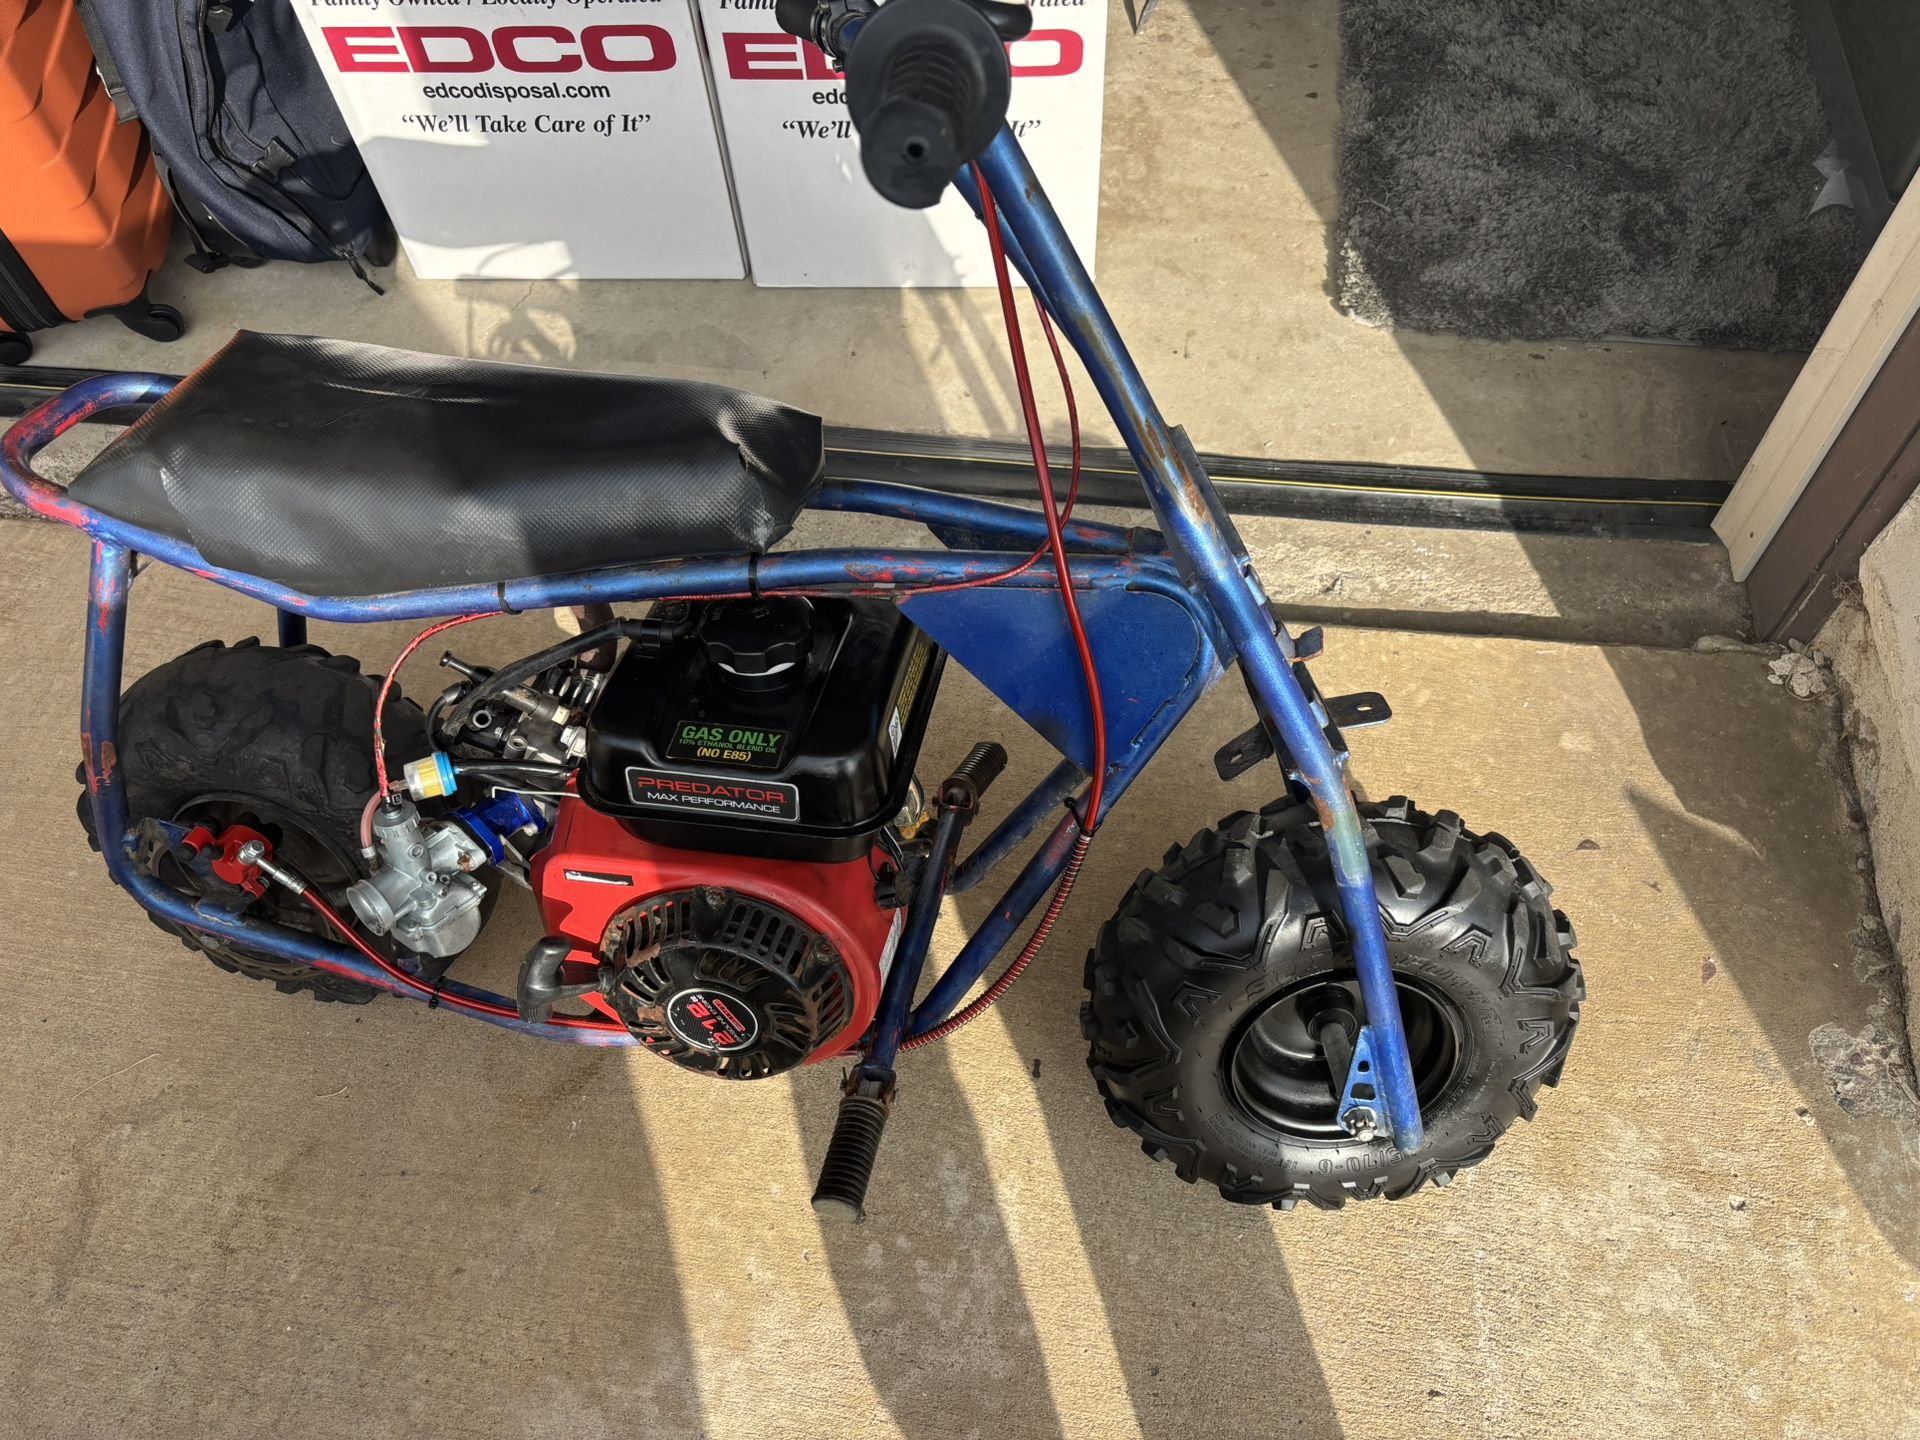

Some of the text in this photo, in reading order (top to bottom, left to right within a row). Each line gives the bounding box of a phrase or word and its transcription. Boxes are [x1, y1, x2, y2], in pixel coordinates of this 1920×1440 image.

[321, 25, 677, 74] EDCO
[722, 29, 1084, 80] EO
[422, 82, 612, 102] edcodisposal.com
[402, 114, 652, 137] “We’ll Take Care of It”
[782, 120, 851, 138] “We’ll
[678, 738, 696, 746] 10%
[697, 740, 734, 750] ETHANOL
[736, 744, 764, 753] BLEND
[682, 725, 782, 747] GAS ONLY
[696, 746, 752, 762] (NO E85)
[637, 776, 786, 805] PREDATOR
[647, 791, 781, 814] MAX PERFORMANCE
